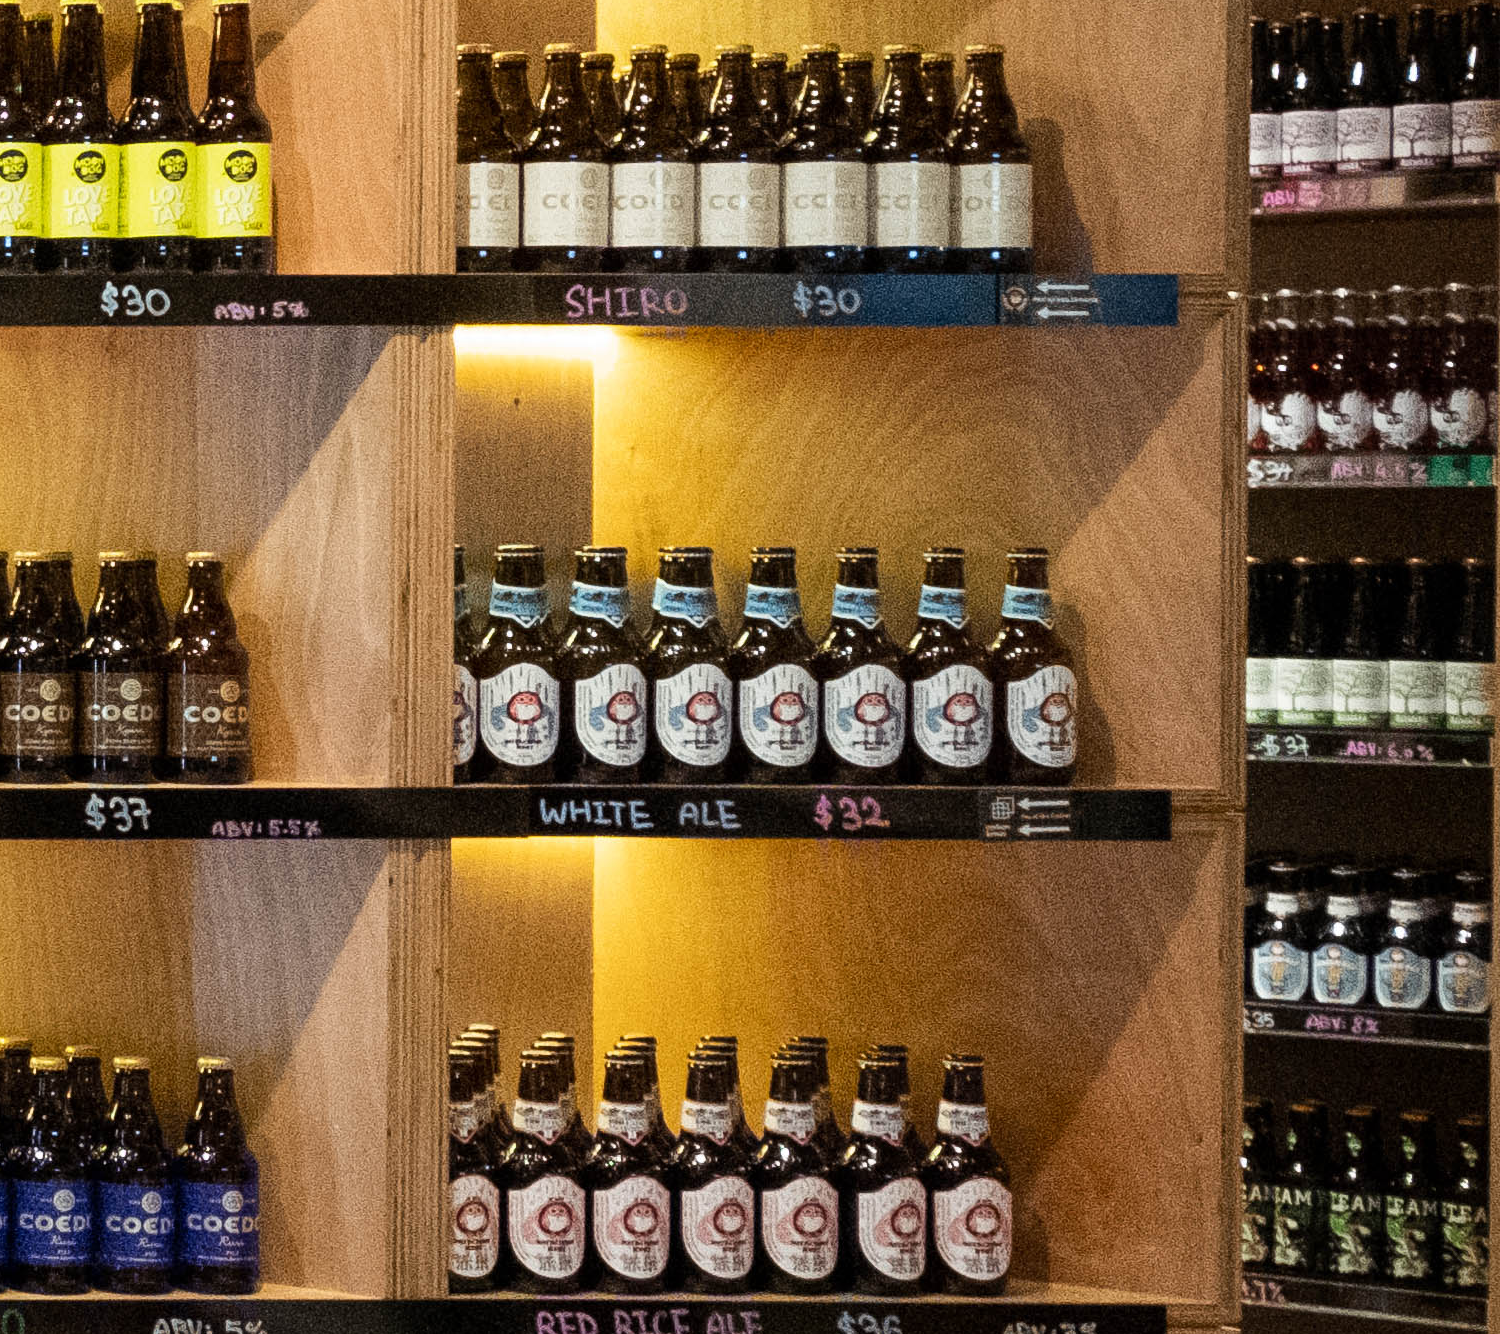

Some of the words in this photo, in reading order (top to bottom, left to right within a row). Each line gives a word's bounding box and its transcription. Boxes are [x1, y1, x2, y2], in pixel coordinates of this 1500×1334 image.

[64, 186, 110, 205] LOVE
[214, 186, 261, 205] LOVE
[65, 201, 104, 226] TAP
[217, 201, 253, 226] TAP
[101, 281, 171, 316] $30
[565, 283, 688, 319] SHIRO
[793, 283, 862, 318] $30
[85, 793, 151, 832] $37
[540, 800, 654, 828] WHITE
[678, 800, 741, 828] ALE
[812, 797, 889, 831] $32
